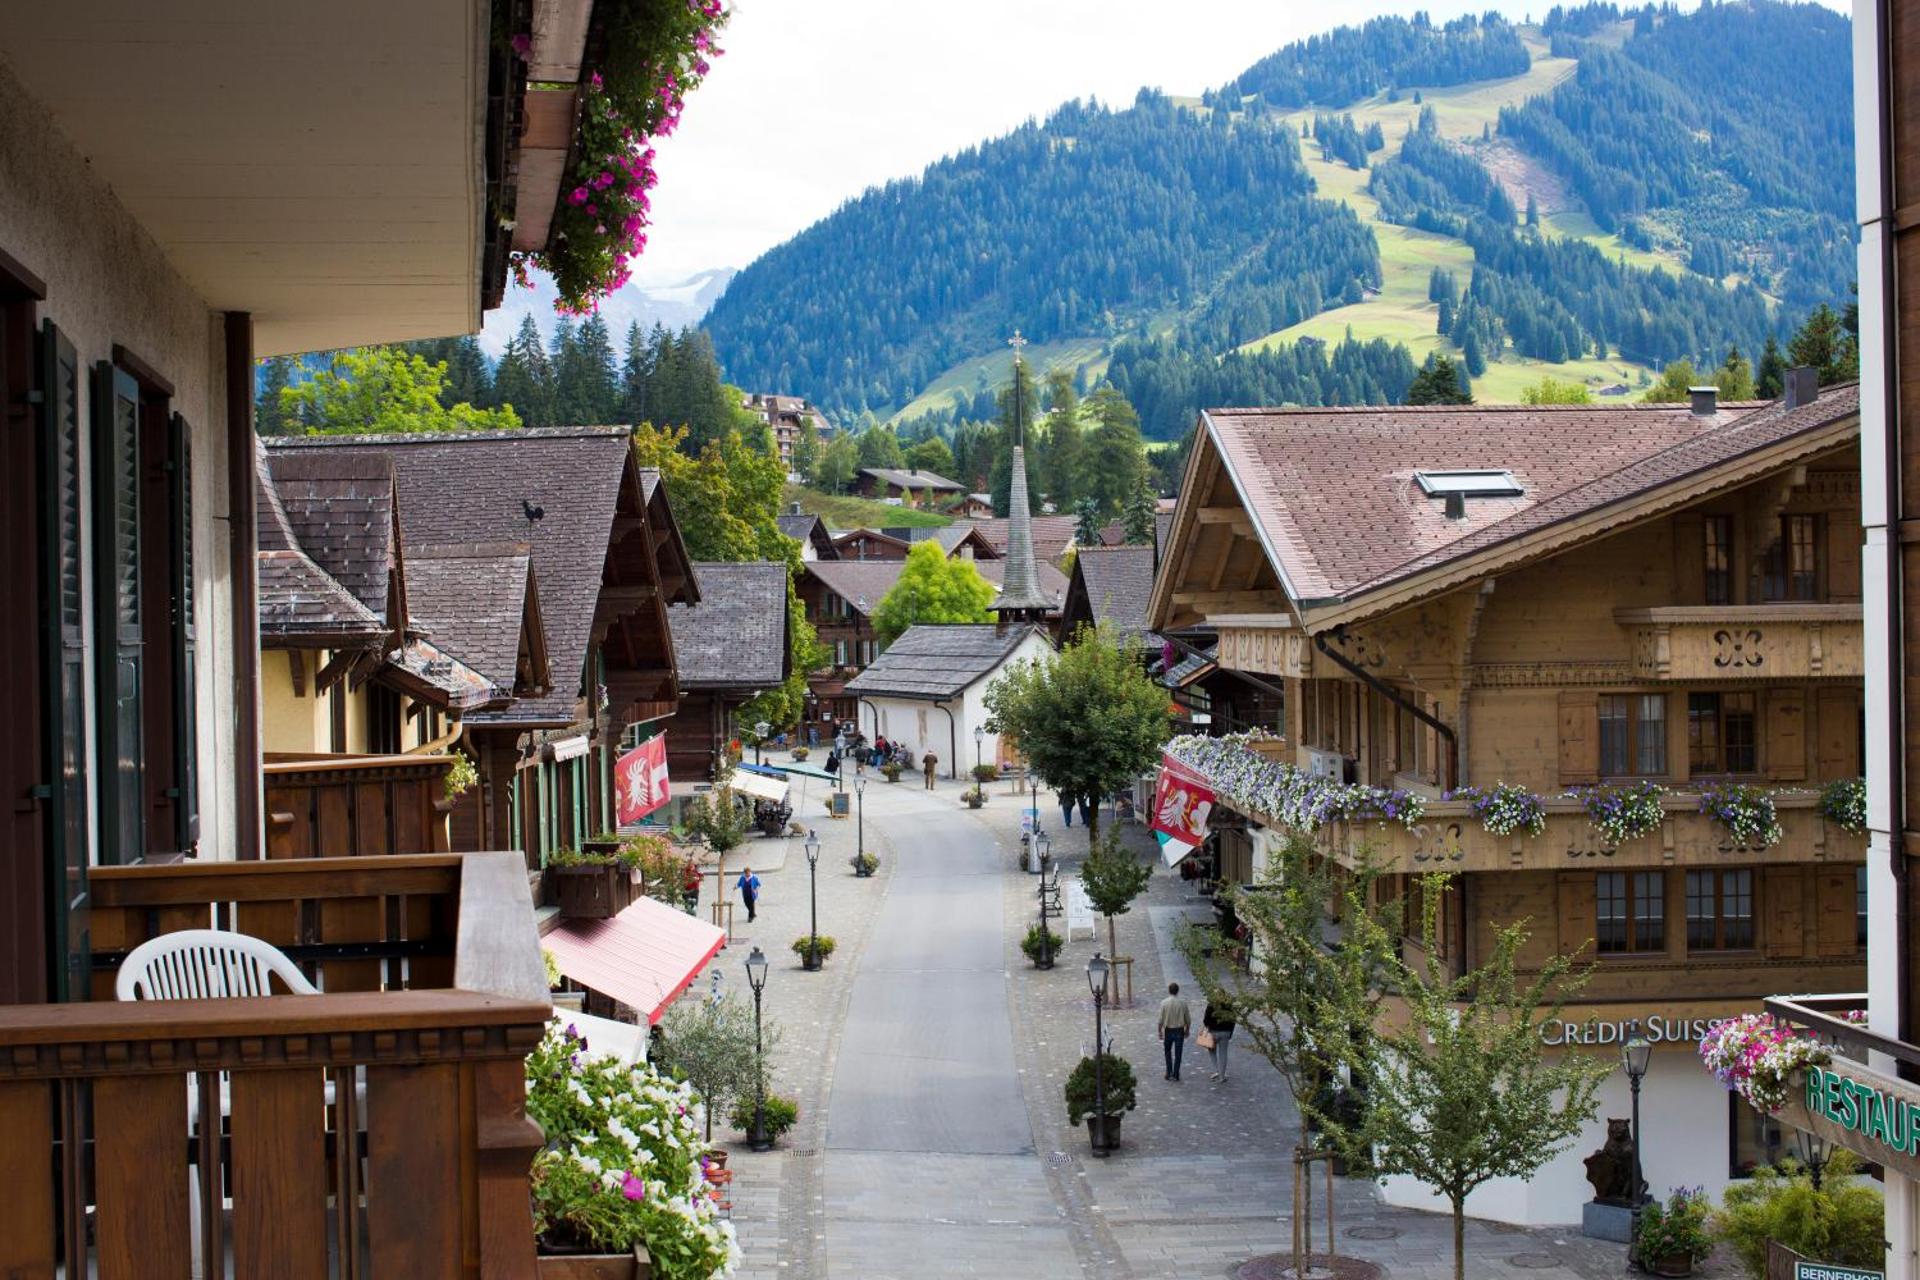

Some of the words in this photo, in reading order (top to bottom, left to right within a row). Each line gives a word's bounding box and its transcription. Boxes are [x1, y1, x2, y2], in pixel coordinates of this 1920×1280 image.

[1540, 1018, 1642, 1045] CREDIT
[1646, 1015, 1734, 1042] SUIS
[1801, 1268, 1880, 1280] BERNERH
